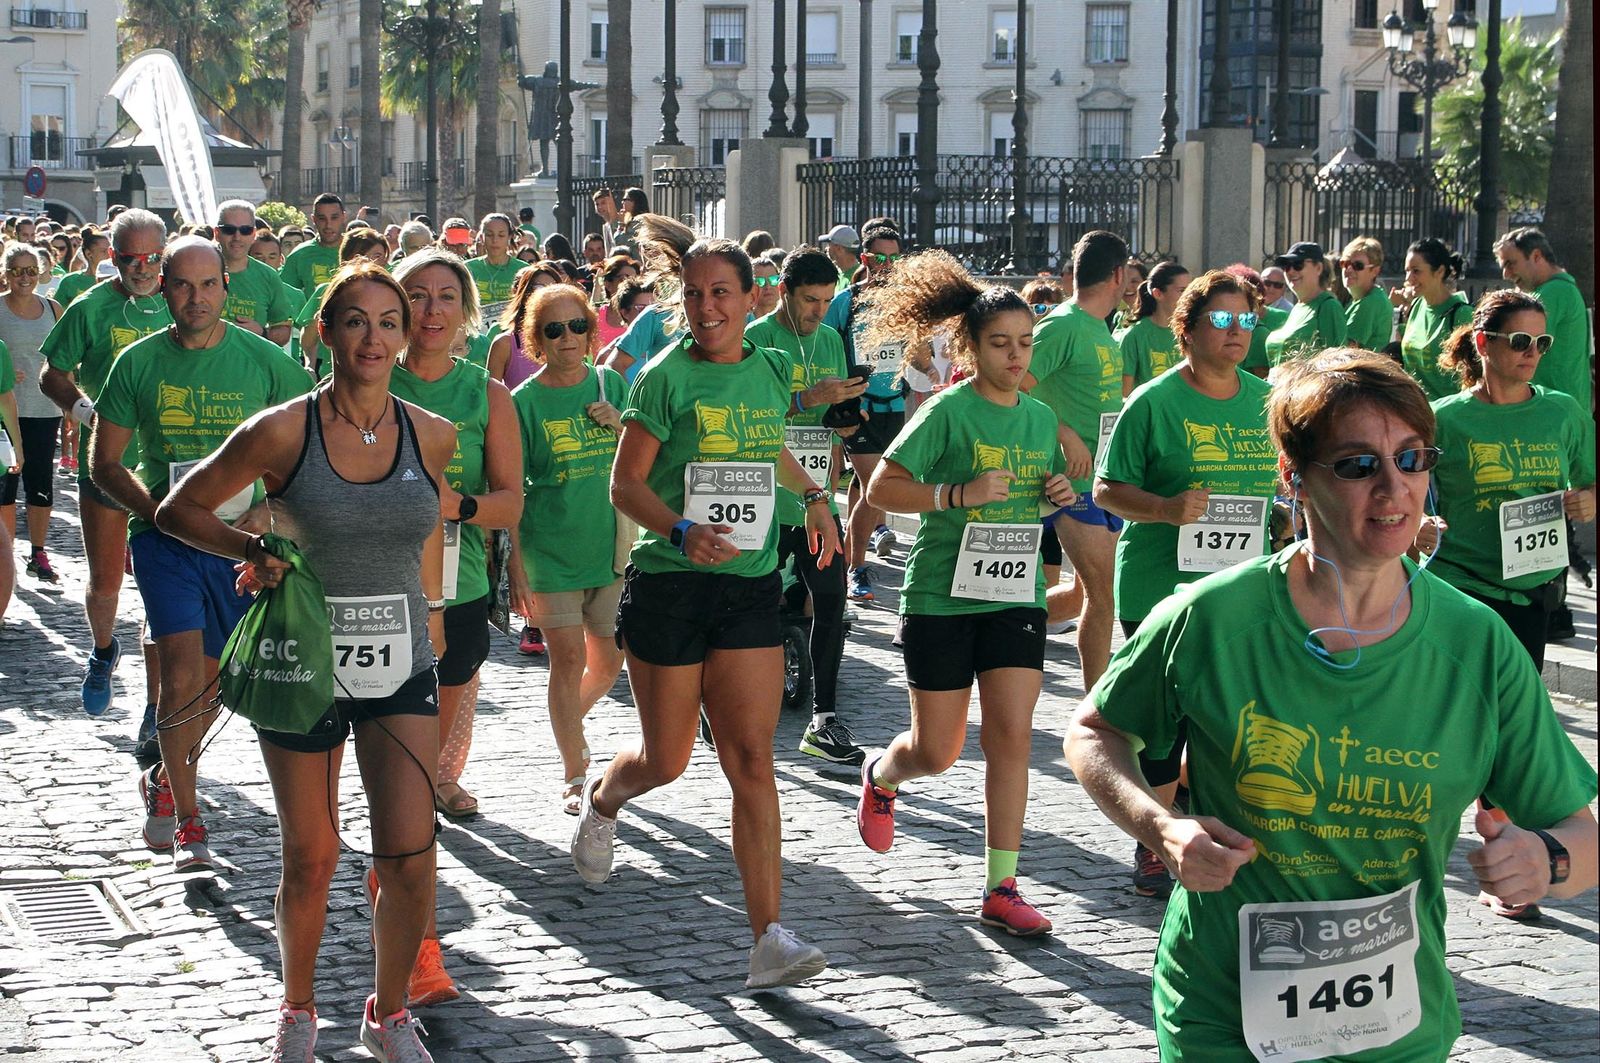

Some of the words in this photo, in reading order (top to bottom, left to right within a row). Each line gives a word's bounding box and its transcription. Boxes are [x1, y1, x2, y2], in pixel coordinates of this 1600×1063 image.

[212, 392, 244, 400] aecc
[202, 405, 243, 417] HUELVA
[752, 408, 780, 419] aecc
[743, 423, 784, 439] HUELVA
[802, 431, 828, 440] aecc
[1527, 442, 1559, 451] aecc
[1026, 450, 1048, 459] aecc
[1519, 456, 1560, 469] HUELVA
[724, 470, 762, 482] aecc
[737, 483, 769, 492] marcha
[708, 503, 757, 523] 305
[1215, 502, 1253, 514] aecc
[1527, 500, 1554, 515] aecc
[1228, 514, 1259, 523] marcha
[997, 531, 1030, 542] aecc
[1194, 531, 1251, 550] 1377
[1514, 528, 1558, 553] 1376
[1007, 543, 1034, 551] marcha
[973, 559, 1027, 579] 1402
[344, 606, 394, 620] aecc
[342, 624, 358, 632] en
[362, 619, 403, 632] marcha
[335, 644, 391, 668] 751
[263, 664, 316, 683] marcha
[1365, 746, 1440, 769] aecc
[1336, 772, 1432, 809] HUELVA
[1327, 802, 1354, 815] en
[1300, 821, 1350, 840] CONTRA
[1354, 827, 1369, 839] EL
[1373, 825, 1427, 844] CÁNCER
[1268, 851, 1301, 865] Obra
[1318, 905, 1394, 941] aecc
[1318, 947, 1346, 961] en
[1350, 922, 1409, 956] marcha
[1277, 963, 1394, 1019] 1461
[1363, 1026, 1388, 1037] Huelva
[1291, 1038, 1324, 1049] HUELVA
